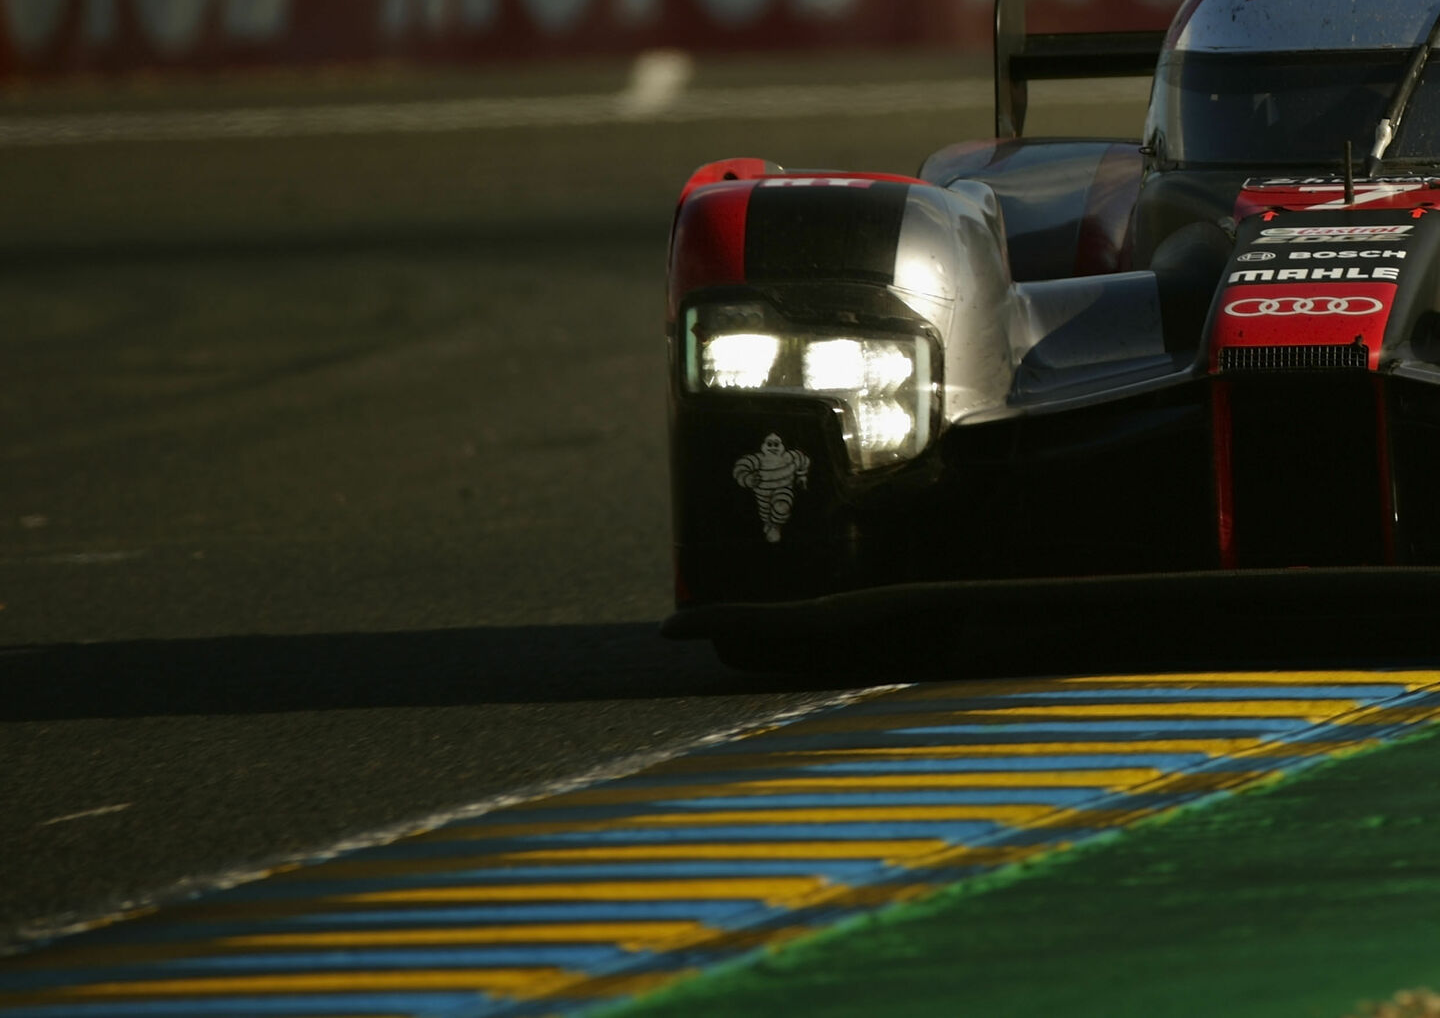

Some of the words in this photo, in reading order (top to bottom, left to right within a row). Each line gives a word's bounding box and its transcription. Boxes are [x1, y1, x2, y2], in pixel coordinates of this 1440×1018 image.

[1295, 225, 1401, 236] Castrol
[1287, 249, 1407, 260] BOSCH
[1227, 266, 1400, 283] MAHLE
